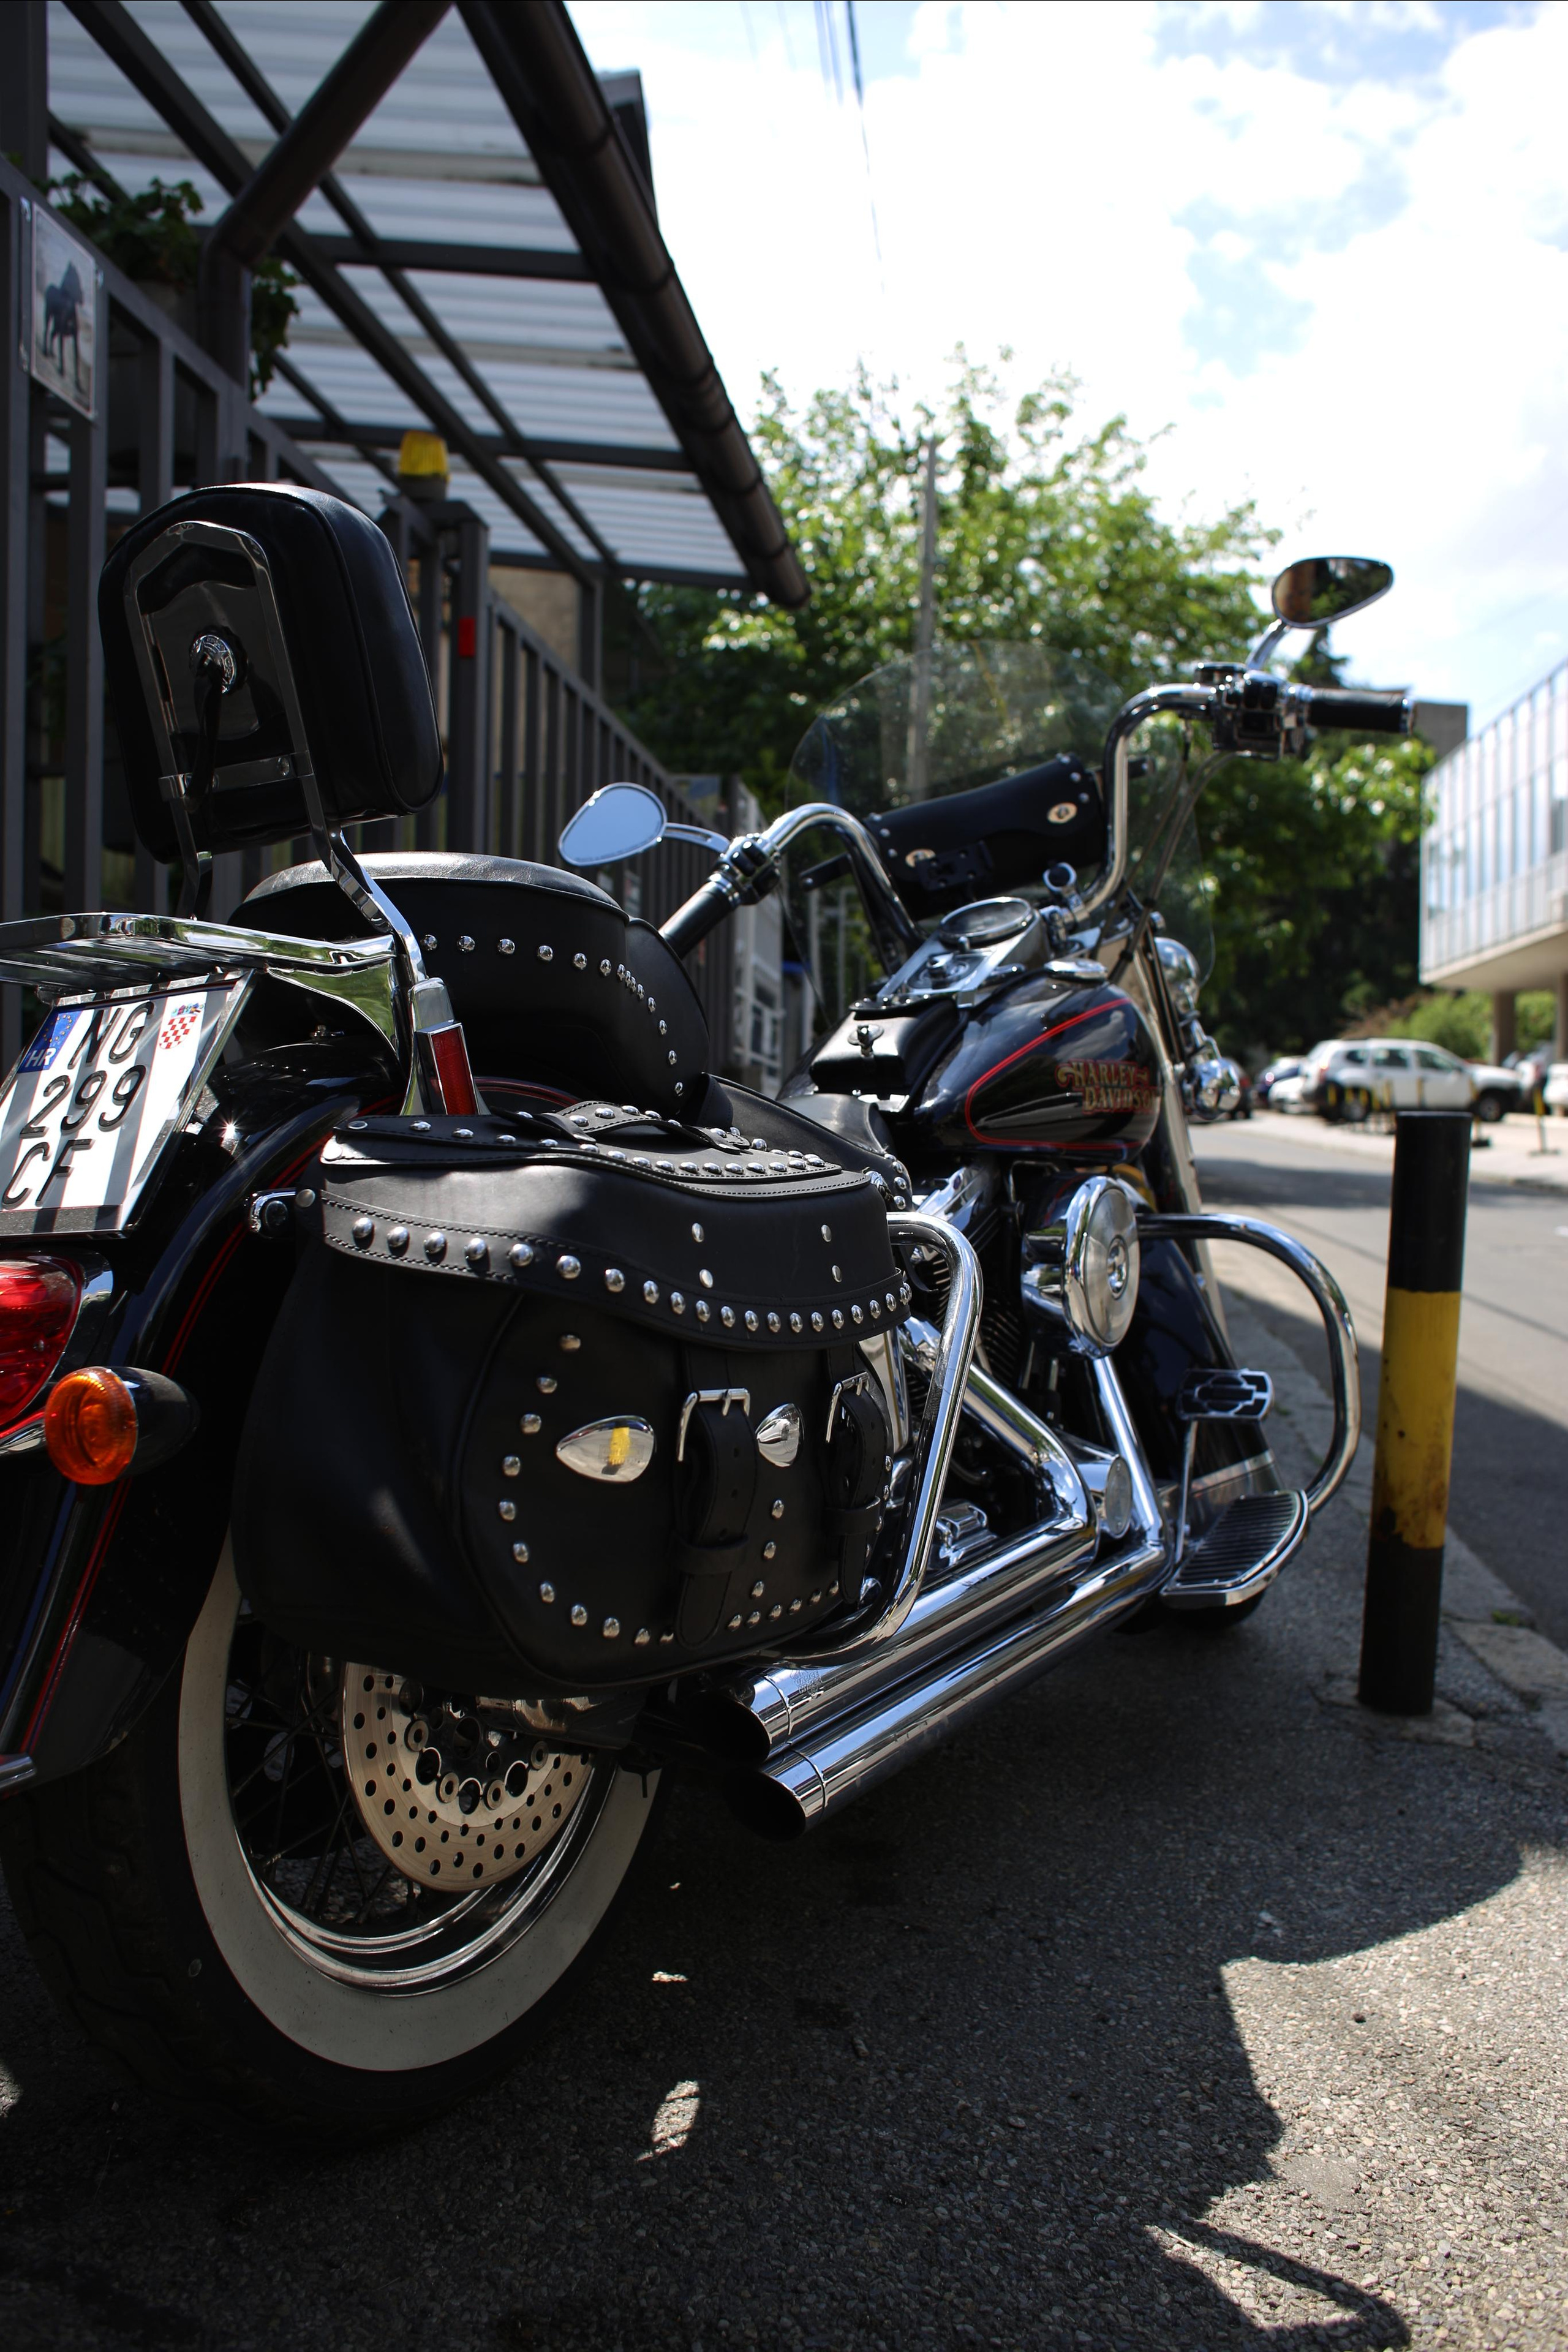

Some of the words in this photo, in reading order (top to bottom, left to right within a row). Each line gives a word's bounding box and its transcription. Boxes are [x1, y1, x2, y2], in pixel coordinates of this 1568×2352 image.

[26, 1048, 56, 1068] HR
[68, 1001, 155, 1069] NG
[20, 1065, 147, 1139] 299
[2, 1139, 95, 1209] CF
[796, 1671, 820, 1685] VANCE
